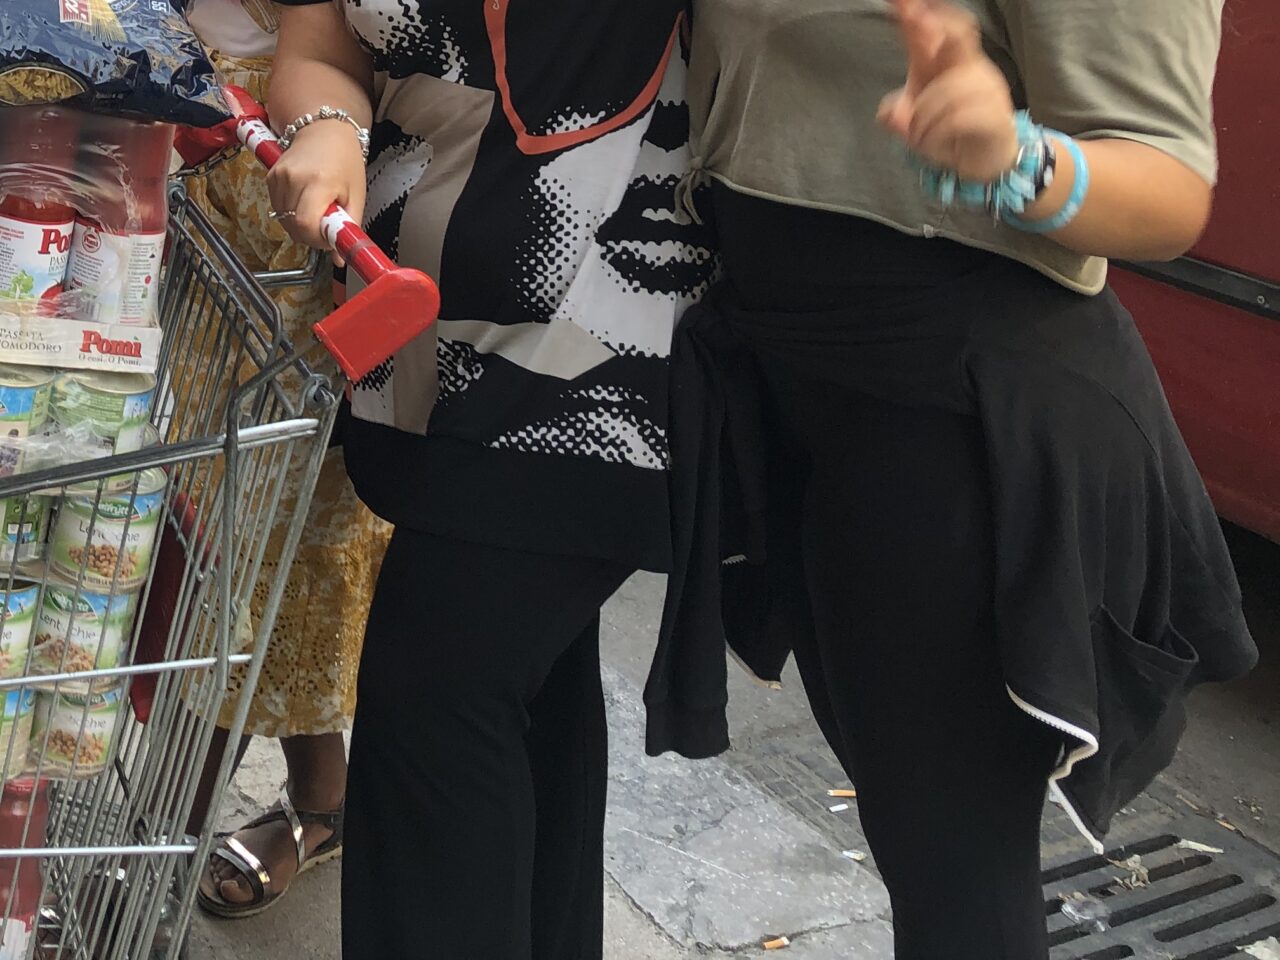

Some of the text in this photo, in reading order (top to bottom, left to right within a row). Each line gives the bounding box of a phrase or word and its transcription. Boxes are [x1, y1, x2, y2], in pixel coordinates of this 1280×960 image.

[38, 229, 73, 254] Po
[0, 327, 44, 341] PASSATA
[80, 330, 142, 358] Pomì
